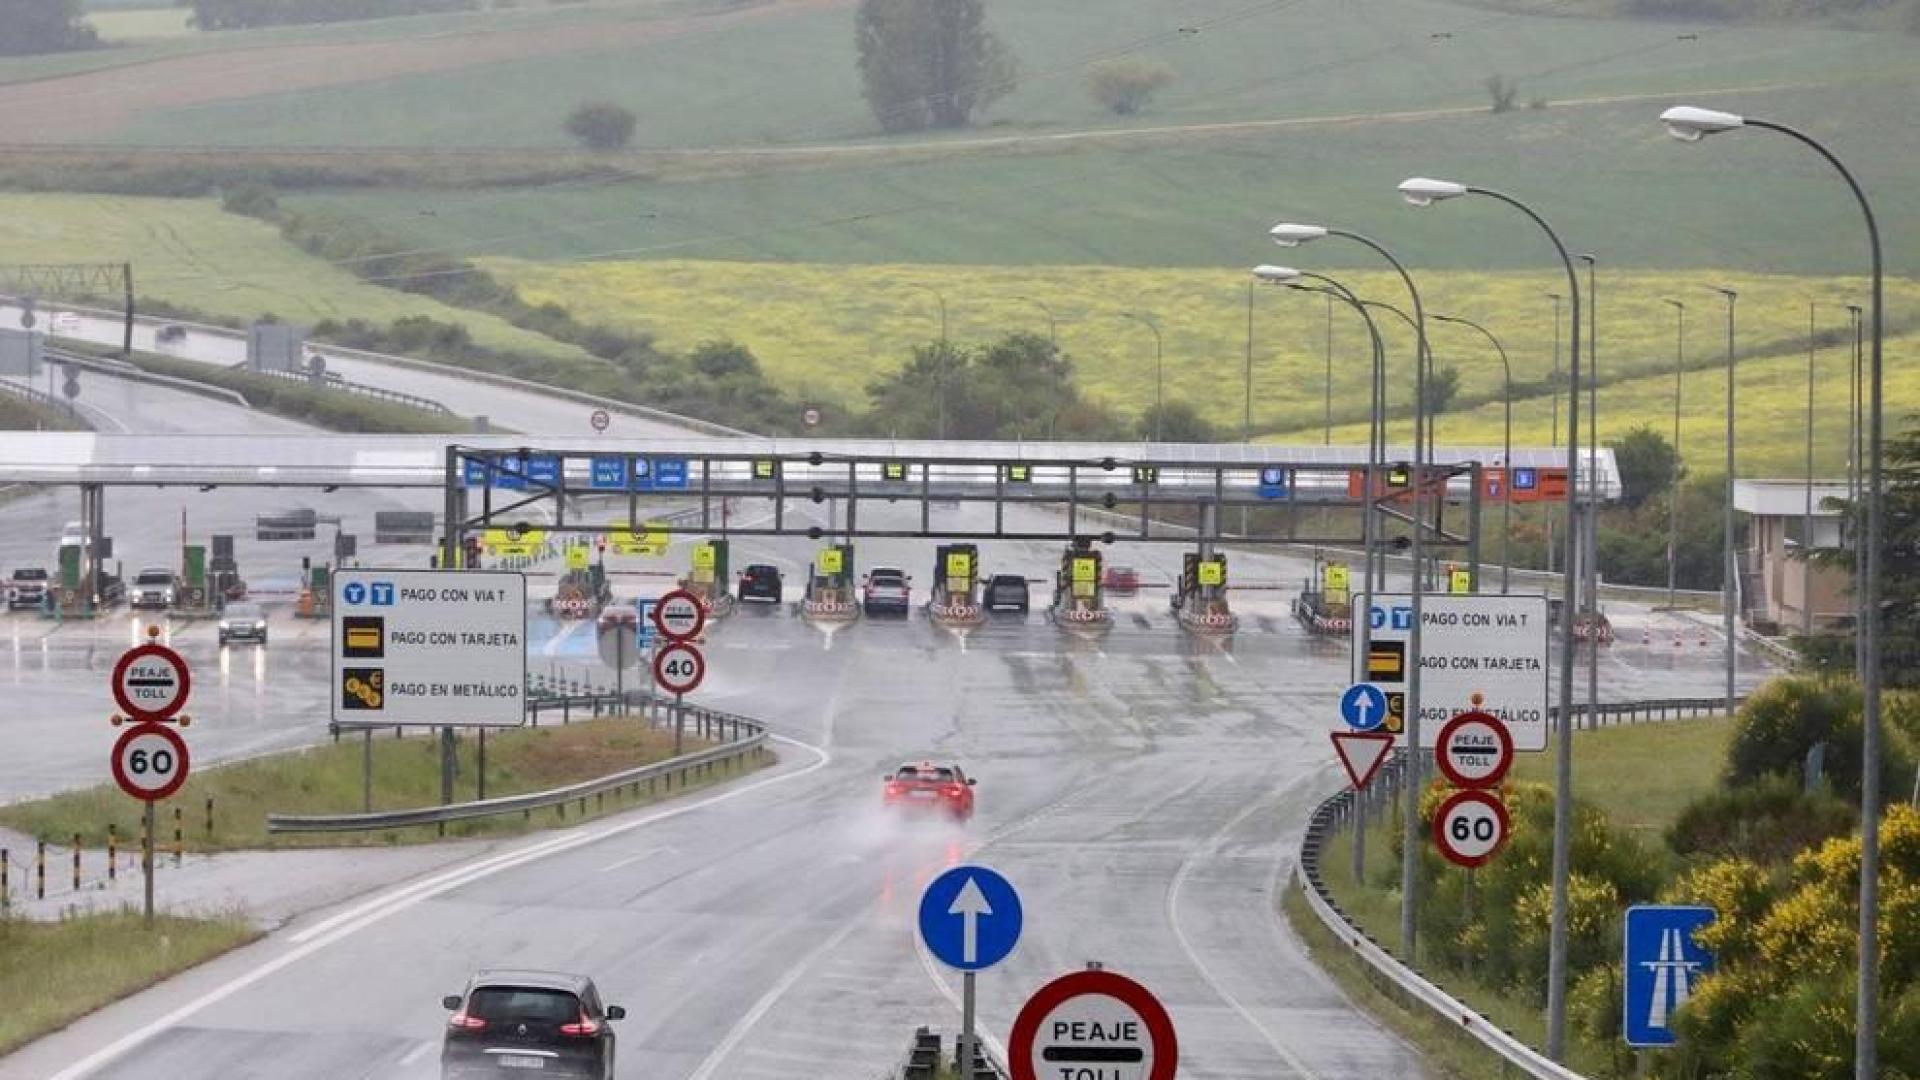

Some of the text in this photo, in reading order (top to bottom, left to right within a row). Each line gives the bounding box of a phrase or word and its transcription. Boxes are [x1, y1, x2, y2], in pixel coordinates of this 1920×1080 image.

[401, 588, 436, 601] PAGO
[441, 589, 468, 601] CON
[474, 589, 495, 602] VIA
[499, 590, 505, 602] T
[1422, 612, 1457, 625] PAGO
[1462, 613, 1490, 626] CON
[1496, 614, 1517, 626] VIA
[1521, 614, 1527, 626] T
[391, 632, 517, 646] PAGO CON TARJETA
[665, 660, 693, 676] 40
[1419, 656, 1541, 670] AGO CON TARJETA
[131, 667, 170, 677] PEAJE
[135, 688, 167, 699] TOLL
[391, 680, 518, 697] PAGO EN METÁLICO
[1420, 707, 1448, 720] AGO
[1455, 734, 1494, 745] PEAJE
[130, 750, 172, 775] 60
[1458, 756, 1490, 767] TOLL
[1452, 816, 1494, 841] 60
[1053, 1021, 1138, 1042] PEAJE
